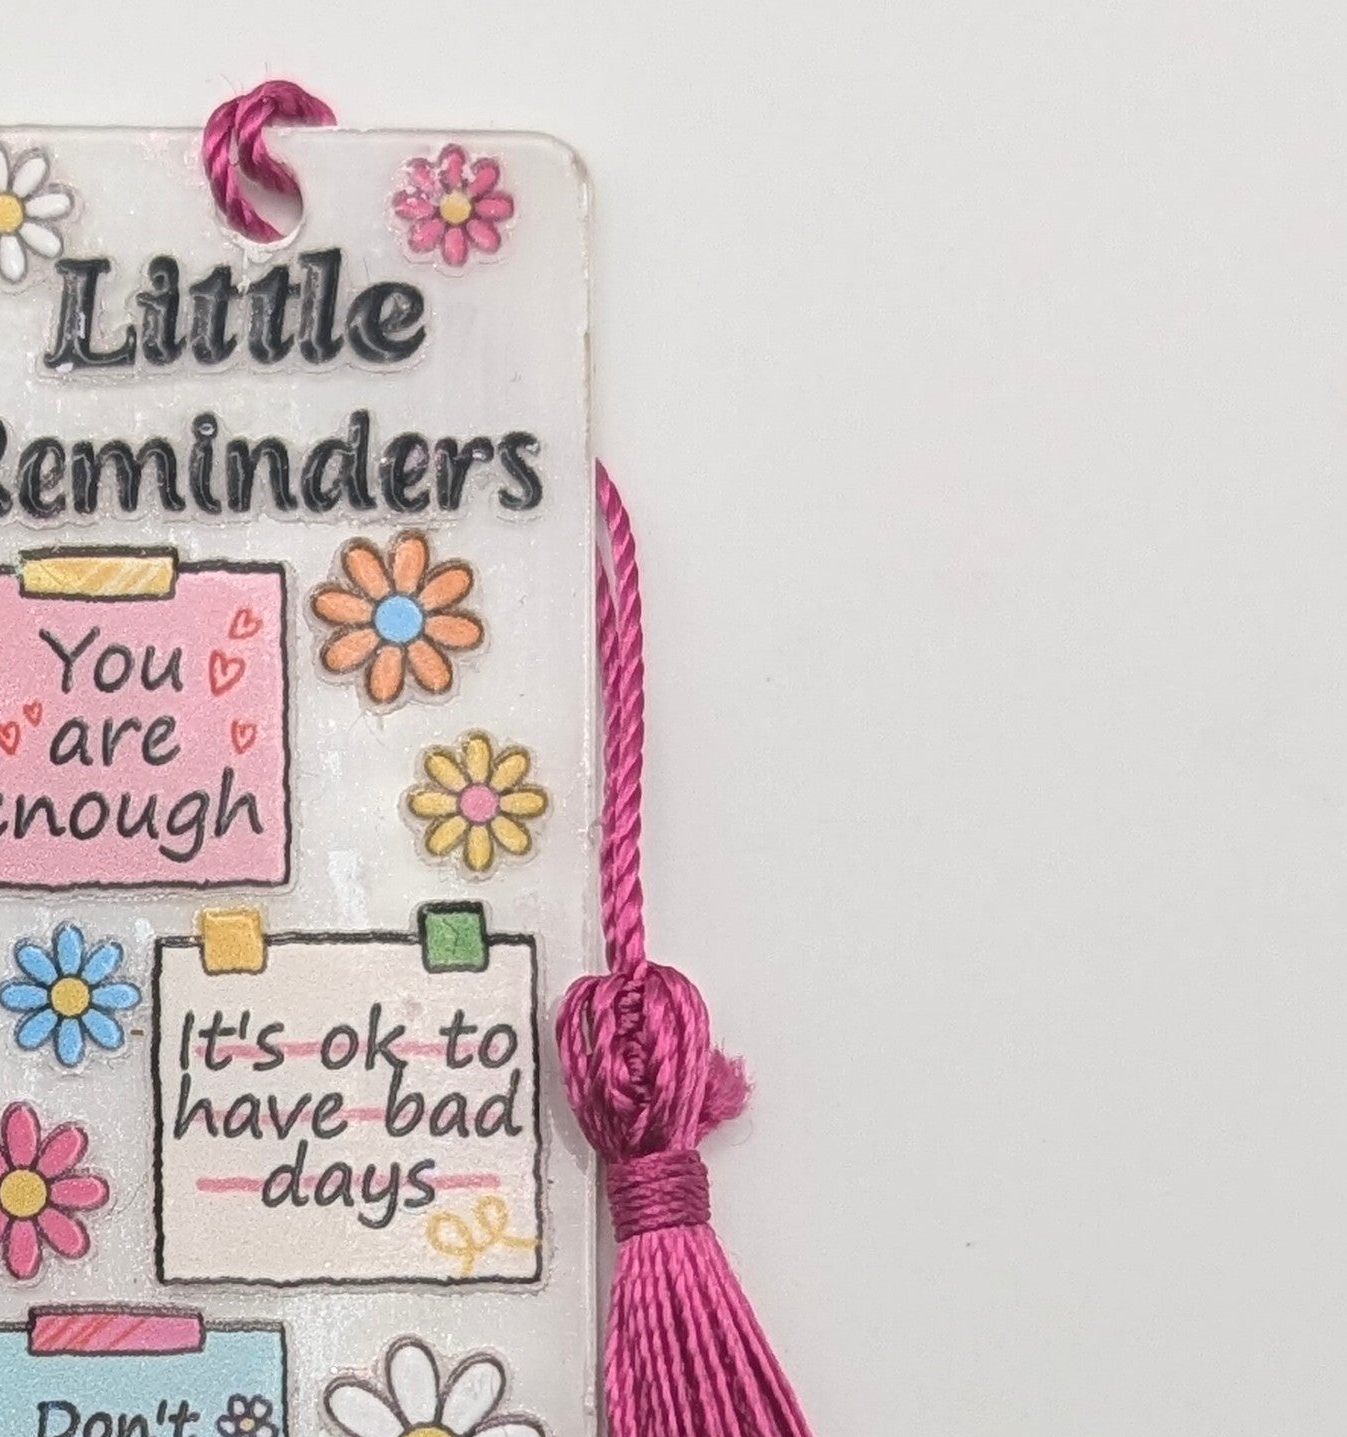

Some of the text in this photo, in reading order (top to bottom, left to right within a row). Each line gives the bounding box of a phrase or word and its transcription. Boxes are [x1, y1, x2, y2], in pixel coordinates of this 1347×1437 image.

[43, 247, 427, 366] Little
[39, 625, 184, 693] You
[49, 715, 180, 768] are
[179, 1004, 517, 1074] It's ok to
[173, 1068, 522, 1142] have bad
[262, 1141, 436, 1228] days
